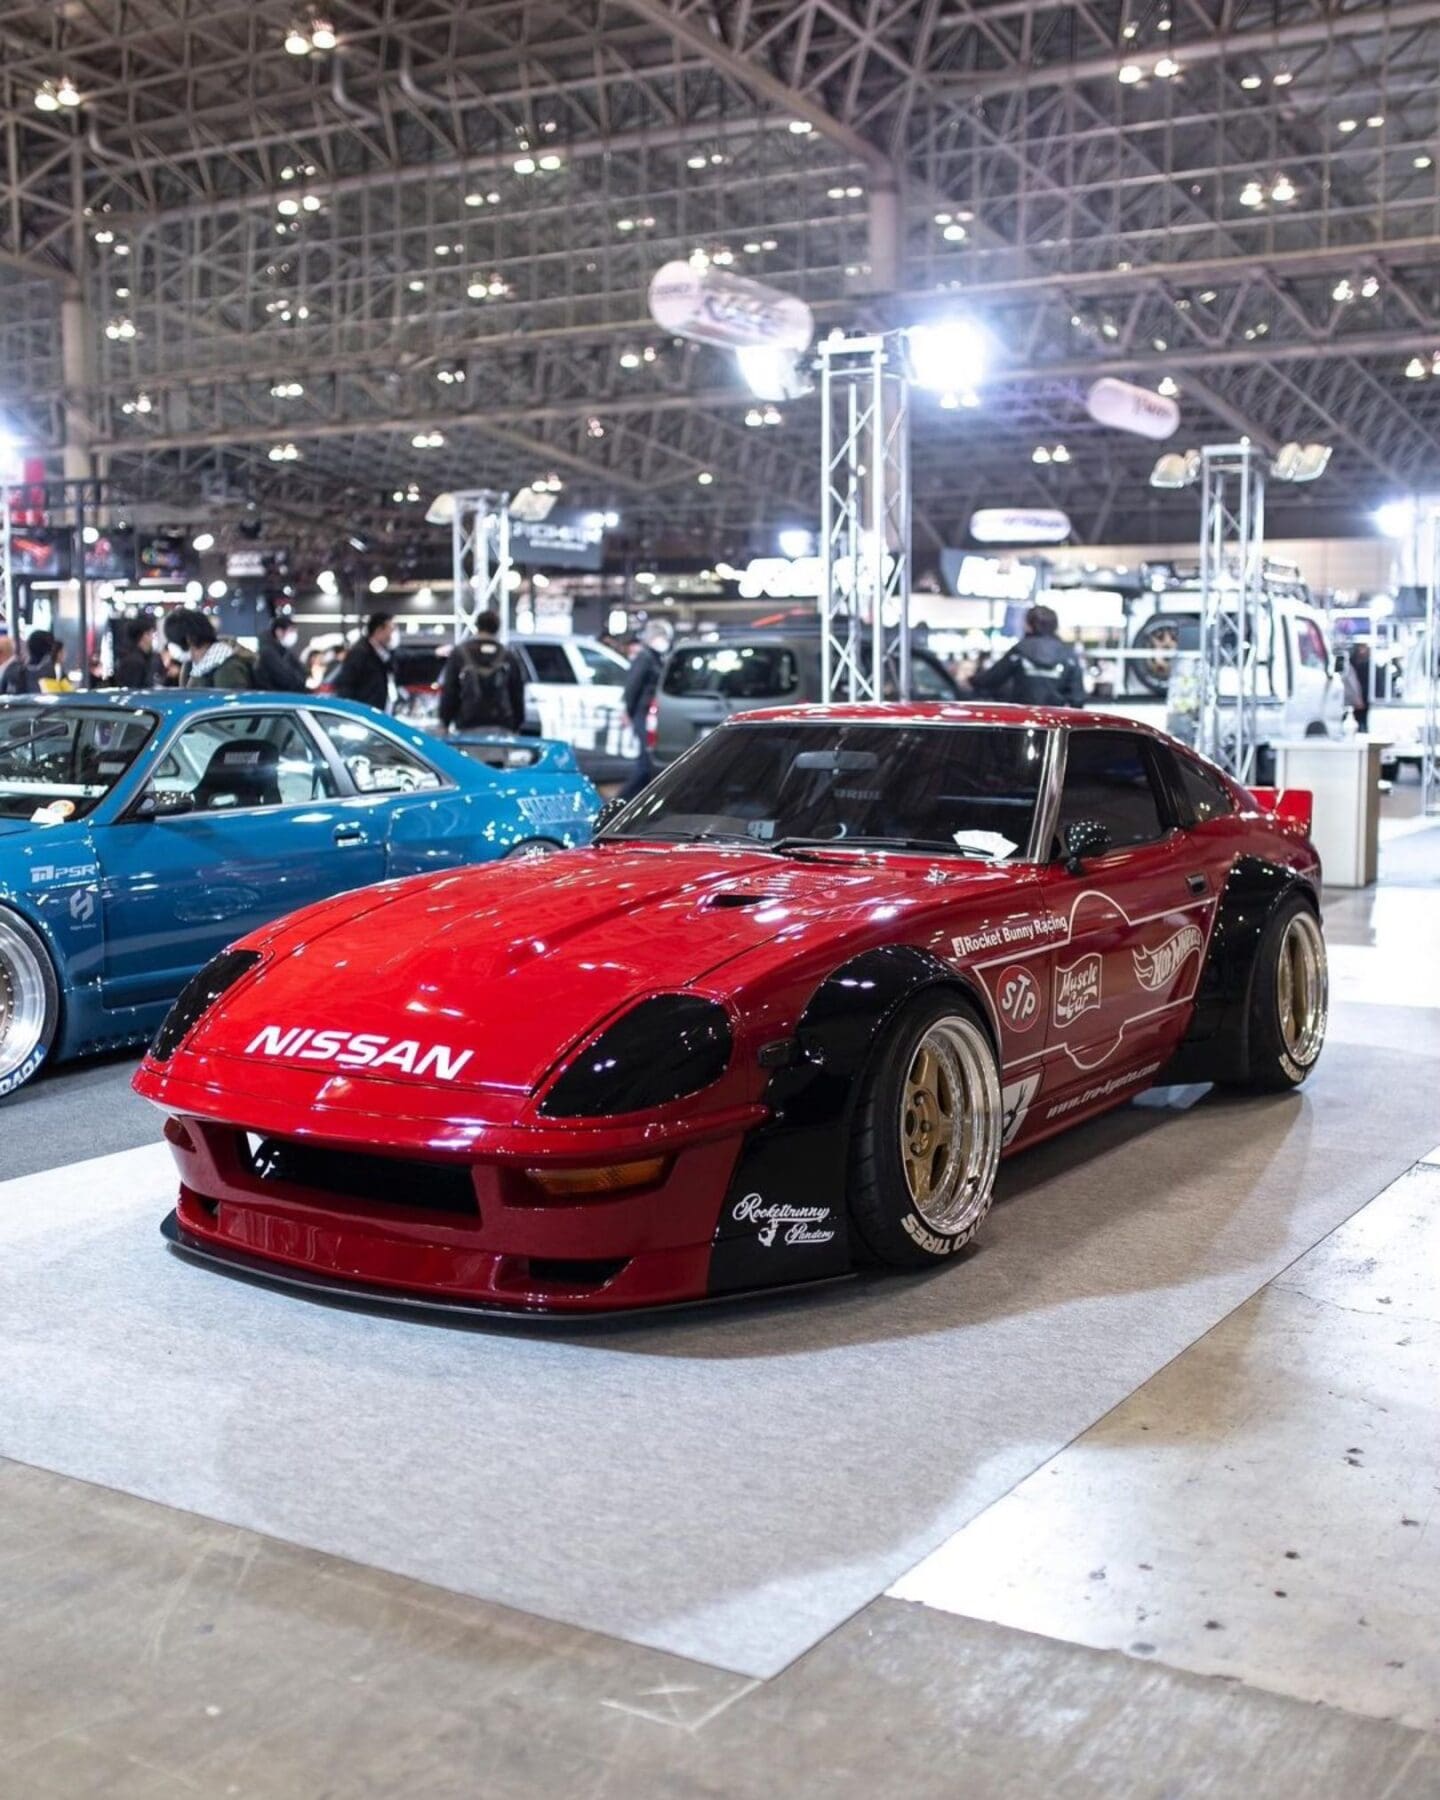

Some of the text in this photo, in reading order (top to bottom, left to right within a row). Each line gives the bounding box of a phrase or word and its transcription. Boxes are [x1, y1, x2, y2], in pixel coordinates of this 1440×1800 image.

[55, 864, 96, 879] PSR
[963, 915, 1069, 953] Rocket Bunny Racing
[1001, 973, 1036, 1020] STP
[1058, 962, 1098, 1002] Muscle
[0, 1049, 45, 1096] TOYO
[244, 1024, 475, 1081] NISSAN
[900, 1212, 951, 1255] TIRES
